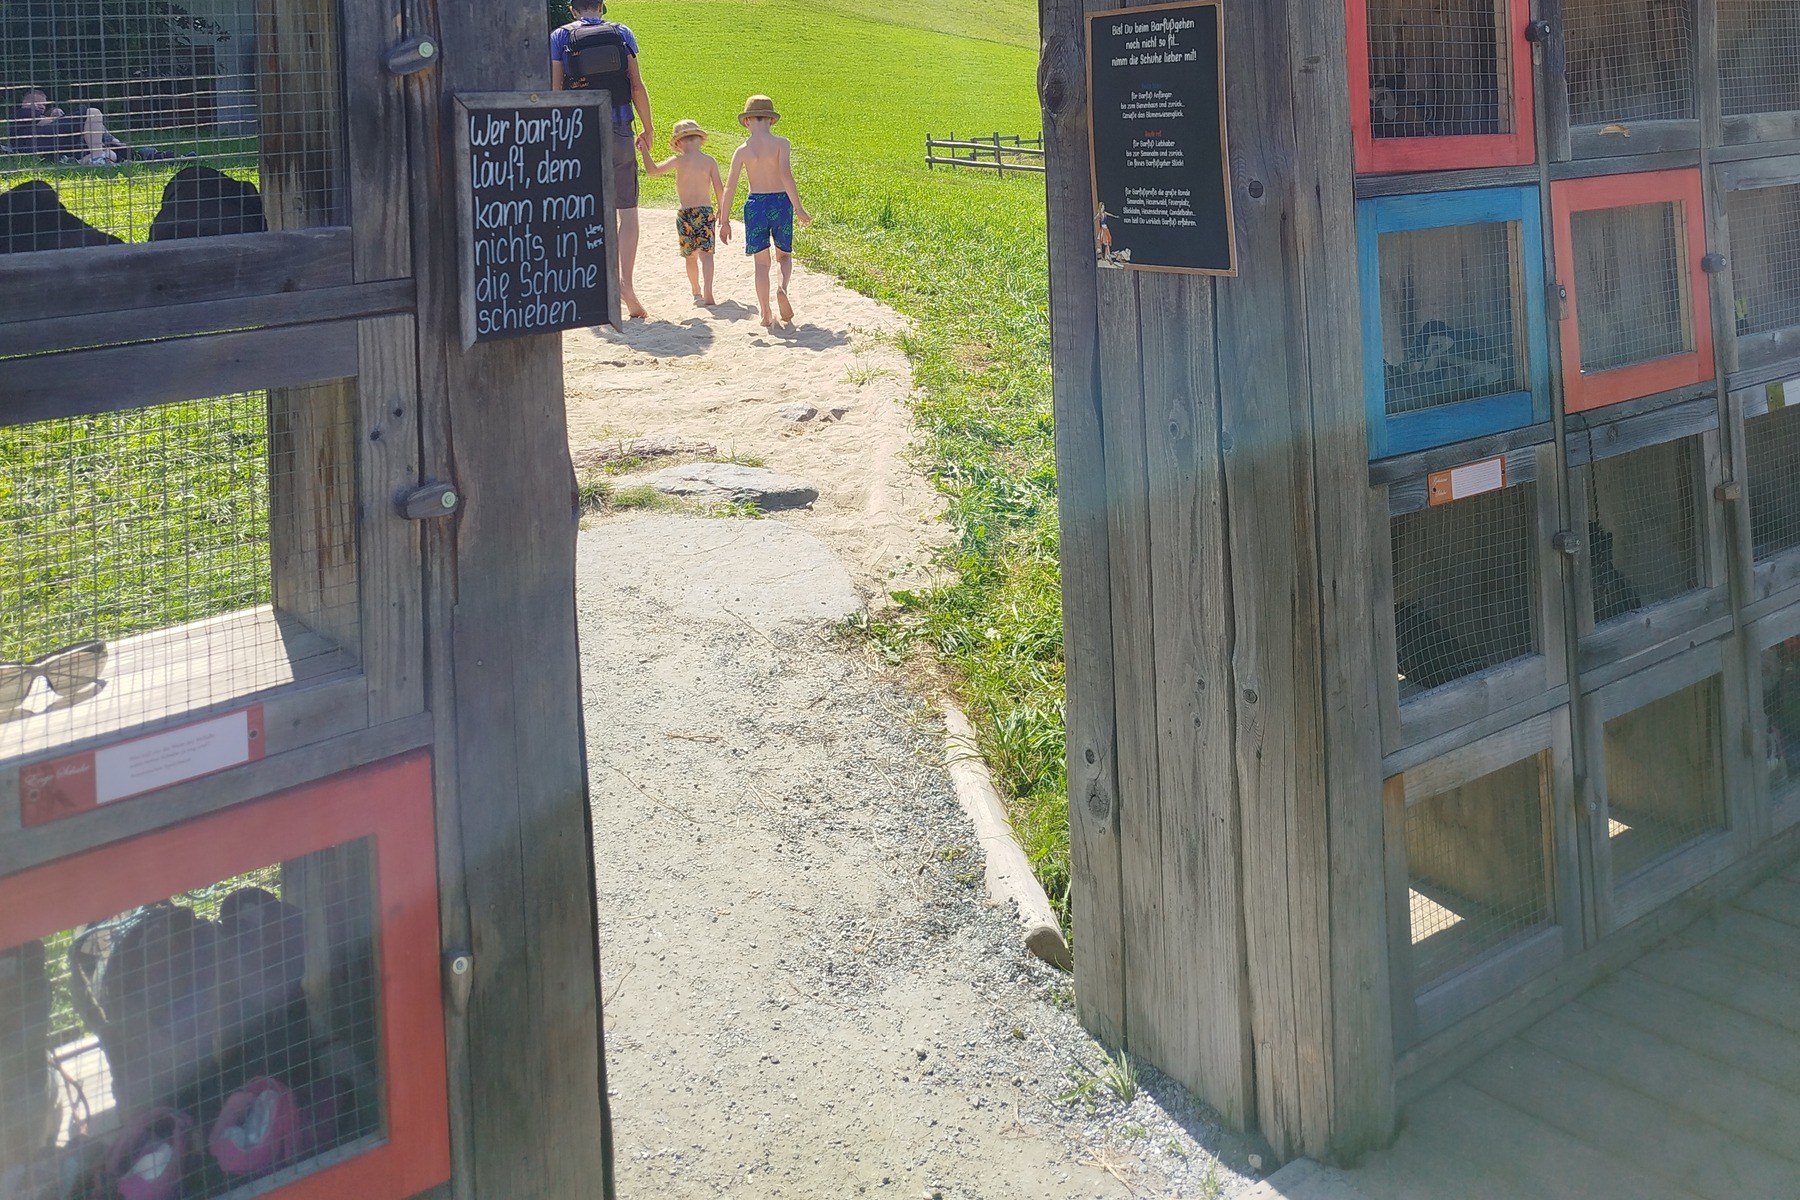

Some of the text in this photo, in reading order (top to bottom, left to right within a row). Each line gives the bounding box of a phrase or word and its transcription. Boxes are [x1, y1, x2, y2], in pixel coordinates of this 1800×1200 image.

[1112, 17, 1195, 36] Bist Du beim Barfußgehen
[1125, 38, 1140, 50] noch
[1142, 35, 1157, 48] nicht
[1158, 38, 1166, 47] so
[1111, 48, 1197, 66] nimm die Schuhe lieber mit!
[470, 108, 583, 151] Wer barfuß
[537, 149, 581, 185] dem
[475, 193, 595, 229] kann man
[475, 224, 578, 266] nichts in
[586, 237, 604, 250] hex
[476, 257, 598, 302] die Schuhe
[478, 295, 582, 334] schieben.
